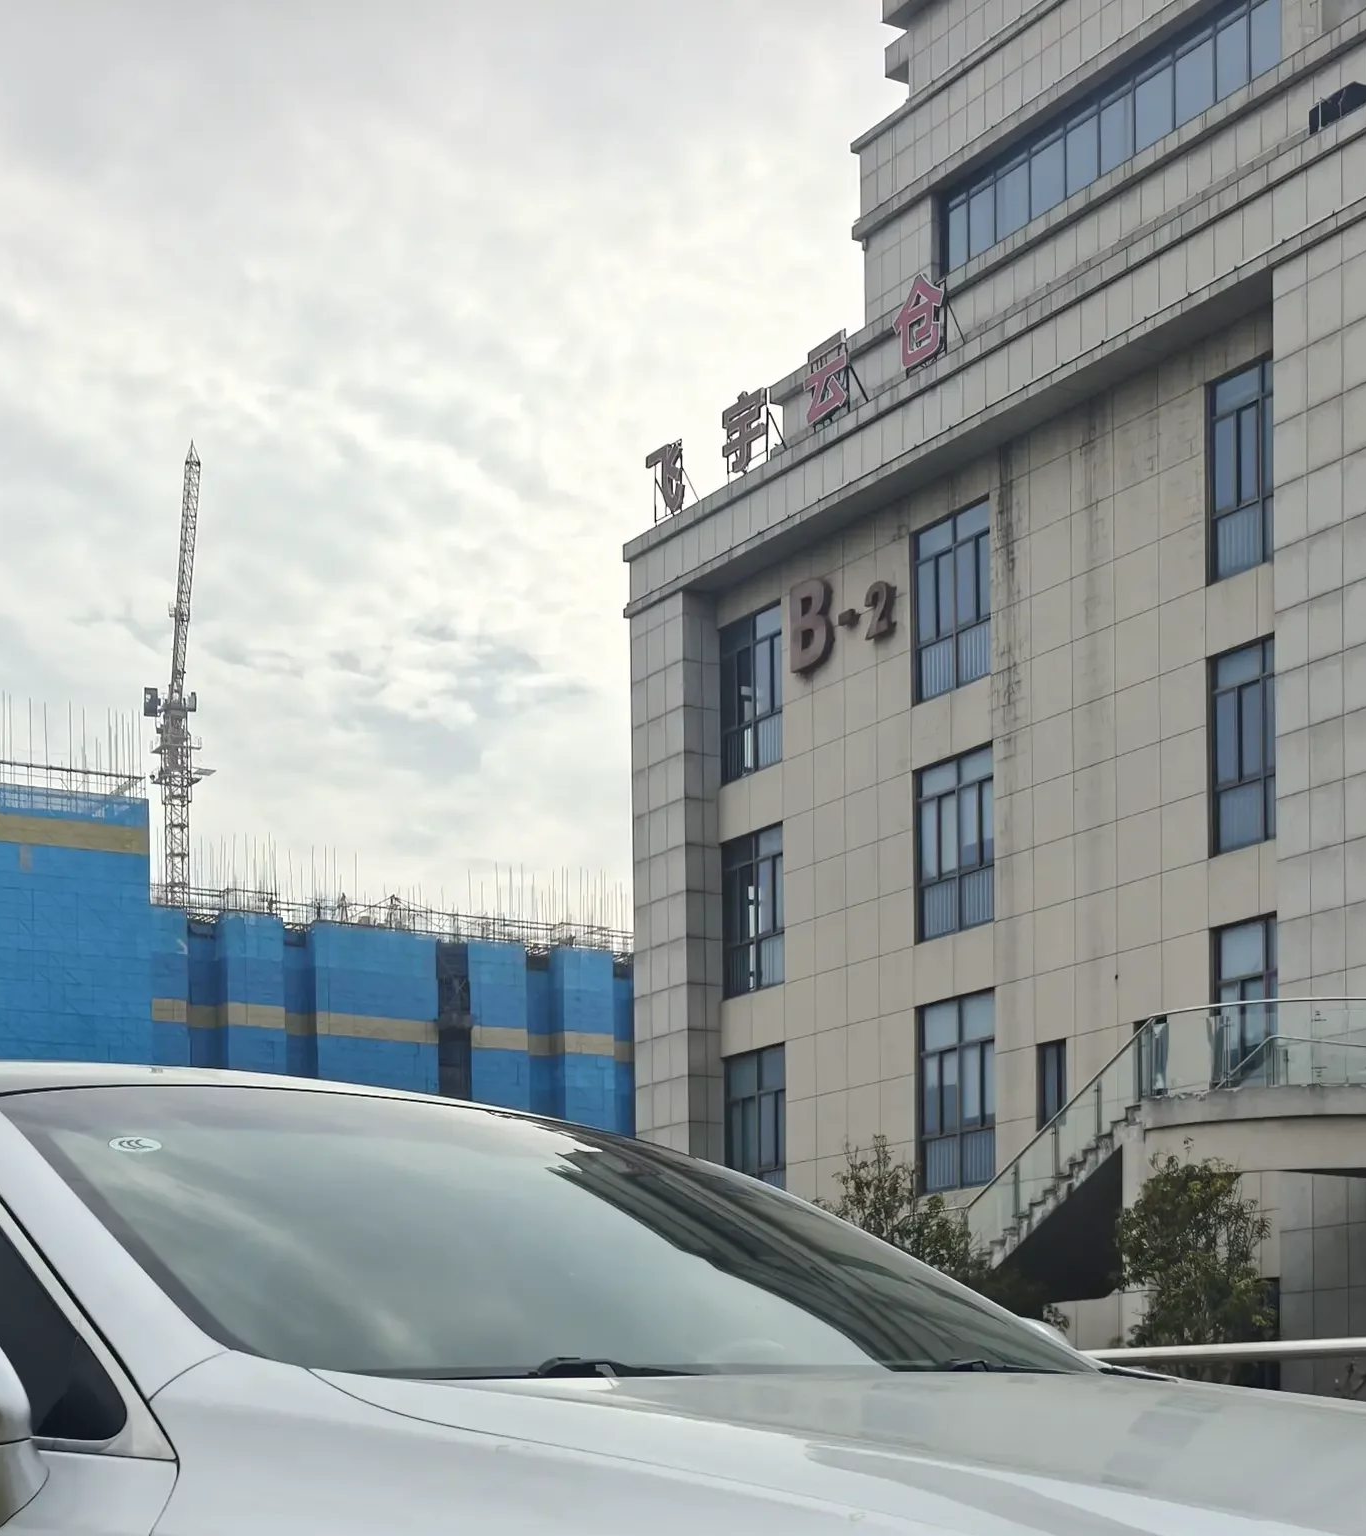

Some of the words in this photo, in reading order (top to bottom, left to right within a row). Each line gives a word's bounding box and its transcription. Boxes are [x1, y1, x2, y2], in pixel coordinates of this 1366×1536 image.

[645, 272, 944, 512] 飞宇云仓
[789, 577, 897, 674] B-2
